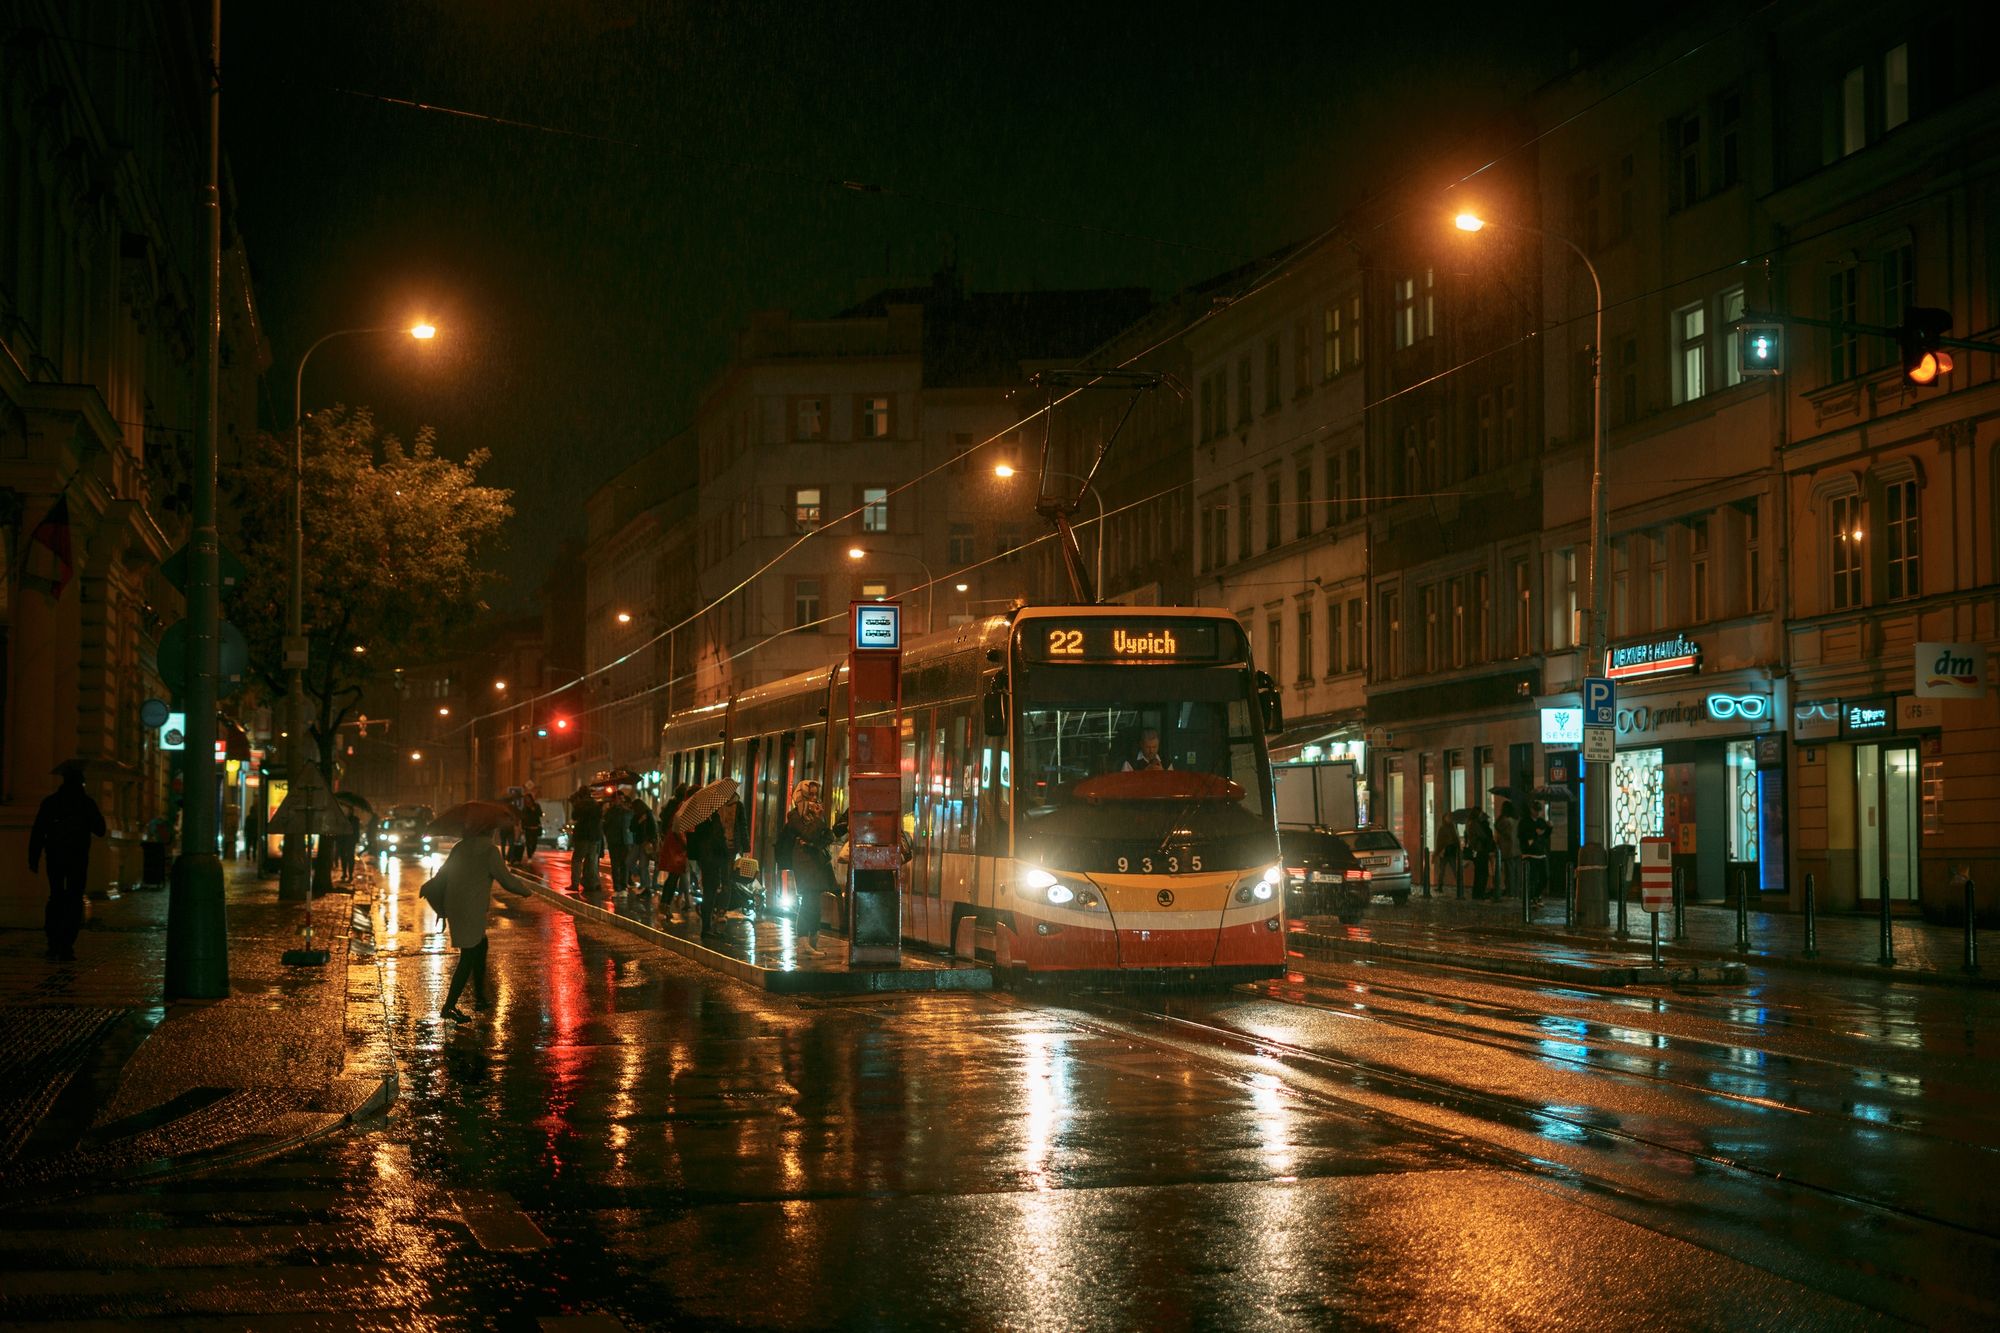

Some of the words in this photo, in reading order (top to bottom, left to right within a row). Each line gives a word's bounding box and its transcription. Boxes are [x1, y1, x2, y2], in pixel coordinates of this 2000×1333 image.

[1049, 630, 1084, 654] 22
[1113, 630, 1176, 654] Vypich
[1613, 645, 1648, 667] MEIXNER
[1934, 650, 1974, 676] dm
[1590, 683, 1609, 711] P
[1117, 856, 1202, 873] 9335
